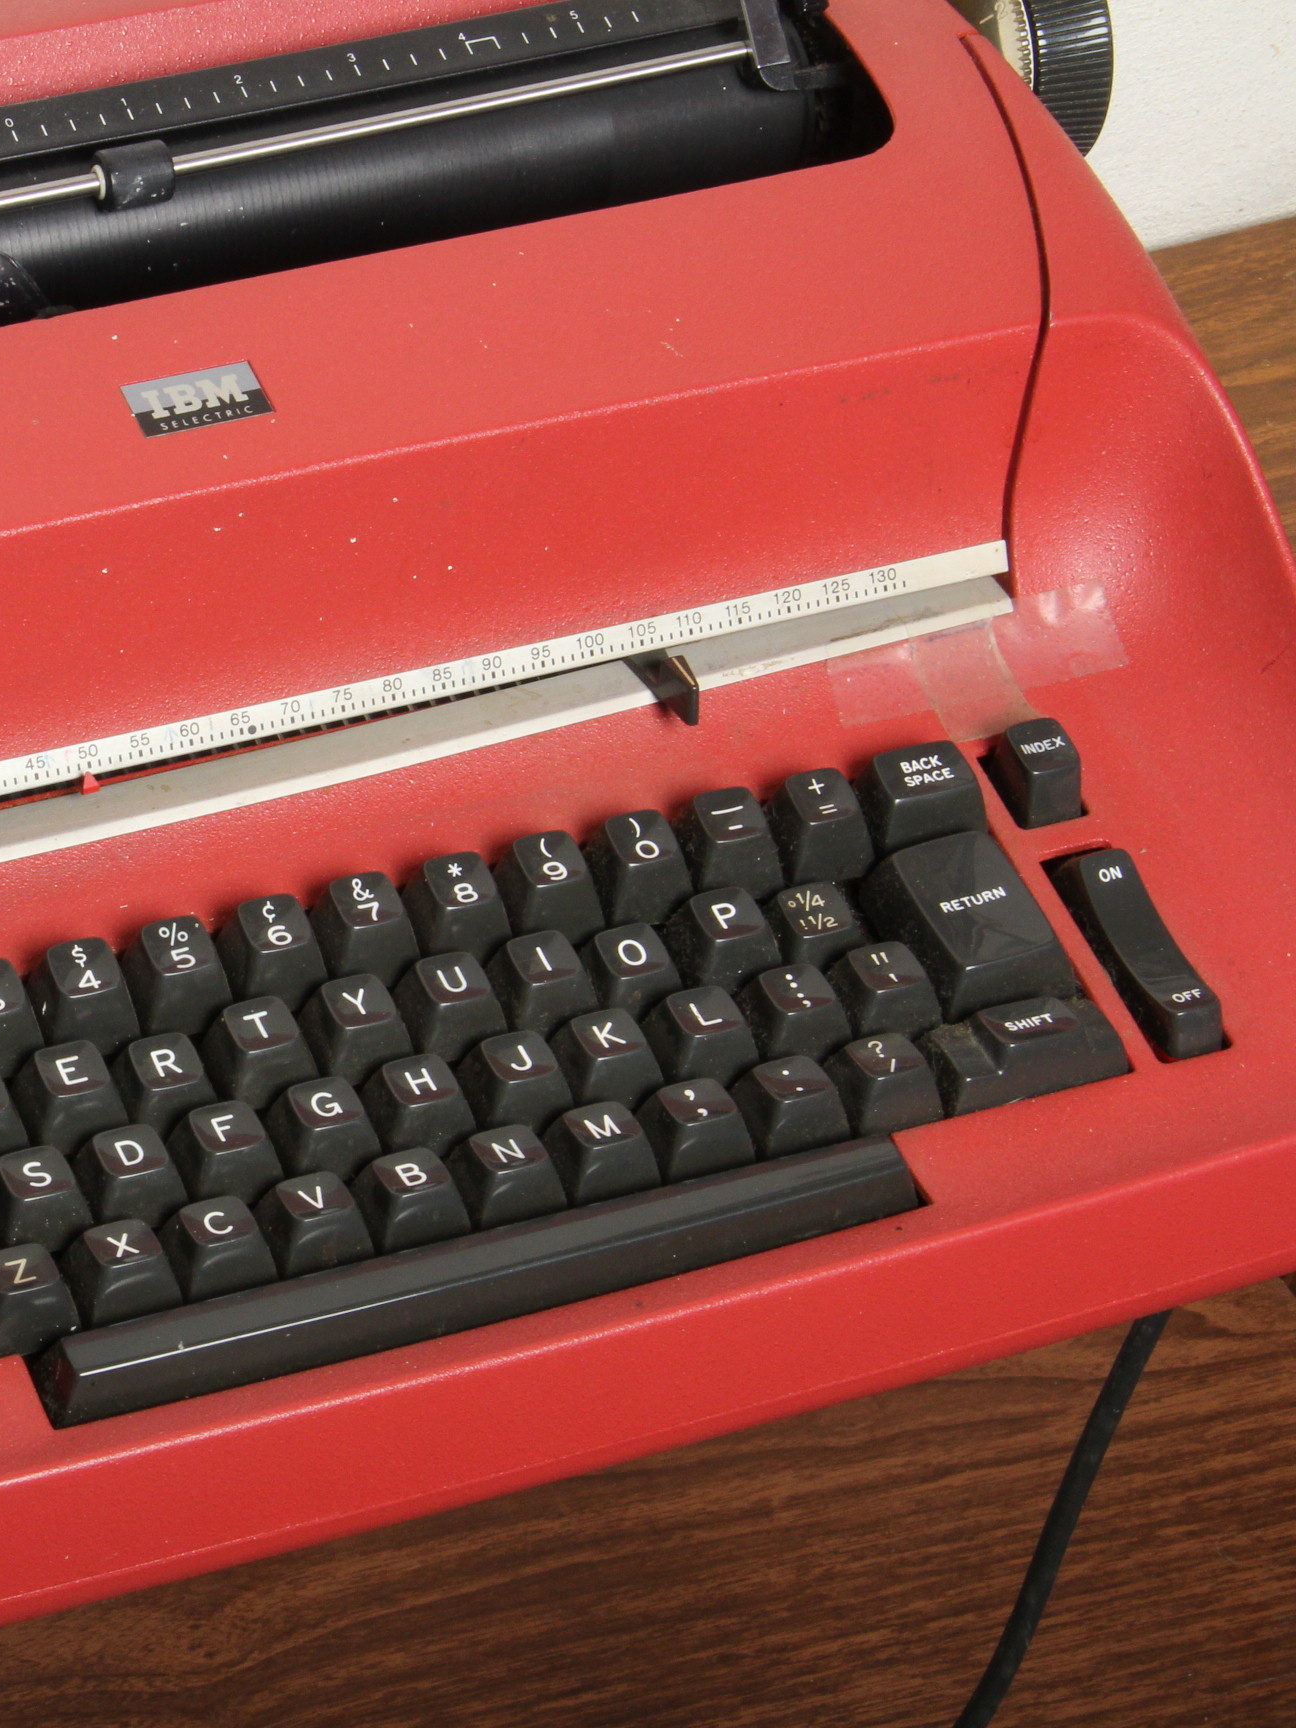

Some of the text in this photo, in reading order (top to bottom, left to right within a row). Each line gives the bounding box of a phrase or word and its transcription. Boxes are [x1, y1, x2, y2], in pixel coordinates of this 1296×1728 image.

[4, 117, 14, 128] 0
[233, 74, 243, 85] 2
[346, 52, 357, 63] 3
[458, 32, 466, 41] 4
[569, 10, 579, 20] 5
[141, 373, 250, 420] IBM
[160, 405, 254, 431] SELECTRIC
[25, 755, 46, 770] 45
[78, 744, 98, 760] 50
[129, 733, 150, 748] 55
[179, 722, 200, 737] 60
[230, 711, 251, 726] 65
[280, 699, 301, 715] 70
[332, 687, 353, 703] 75
[382, 677, 403, 693] 80
[432, 666, 453, 682] 85
[481, 655, 502, 671] 90
[530, 644, 551, 661] 95
[576, 632, 605, 650] 100
[628, 621, 657, 639] 105
[676, 611, 702, 628] 110
[725, 601, 751, 618] 115
[773, 588, 802, 605] 120
[822, 577, 851, 595] 125
[869, 567, 897, 584] 130
[1020, 735, 1066, 755] INDEX
[899, 754, 944, 774] BACK
[903, 767, 955, 788] SPACE
[628, 817, 641, 838] )
[539, 837, 553, 858] (
[542, 861, 568, 881] 9
[1098, 865, 1123, 883] ON
[351, 878, 375, 902] &
[453, 882, 479, 903] 8
[939, 886, 1007, 914] RETURN
[262, 900, 276, 924] ¢
[356, 901, 380, 922] 7
[710, 902, 737, 930] P
[158, 922, 189, 947] %
[267, 924, 293, 946] 6
[71, 944, 87, 968] $
[170, 946, 196, 969] 5
[535, 946, 553, 972] I
[617, 939, 647, 966] O
[78, 969, 102, 989] 4
[436, 965, 468, 993] U
[341, 988, 367, 1015] Y
[1171, 988, 1201, 1003] OFF
[242, 1010, 269, 1039] T
[689, 1002, 723, 1026] L
[1004, 1012, 1053, 1032] SHIFT
[591, 1021, 627, 1049] K
[510, 1044, 533, 1071] J
[867, 1040, 885, 1058] ?
[55, 1055, 89, 1086] E
[150, 1048, 183, 1078] R
[404, 1067, 438, 1095] H
[310, 1091, 344, 1117] G
[210, 1114, 234, 1142] F
[583, 1114, 622, 1139] M
[114, 1139, 144, 1166] D
[491, 1138, 526, 1163] N
[22, 1161, 52, 1188] S
[394, 1162, 428, 1187] B
[297, 1185, 324, 1209] V
[203, 1211, 234, 1235] C
[106, 1232, 140, 1258] X
[4, 1257, 37, 1284] Z
